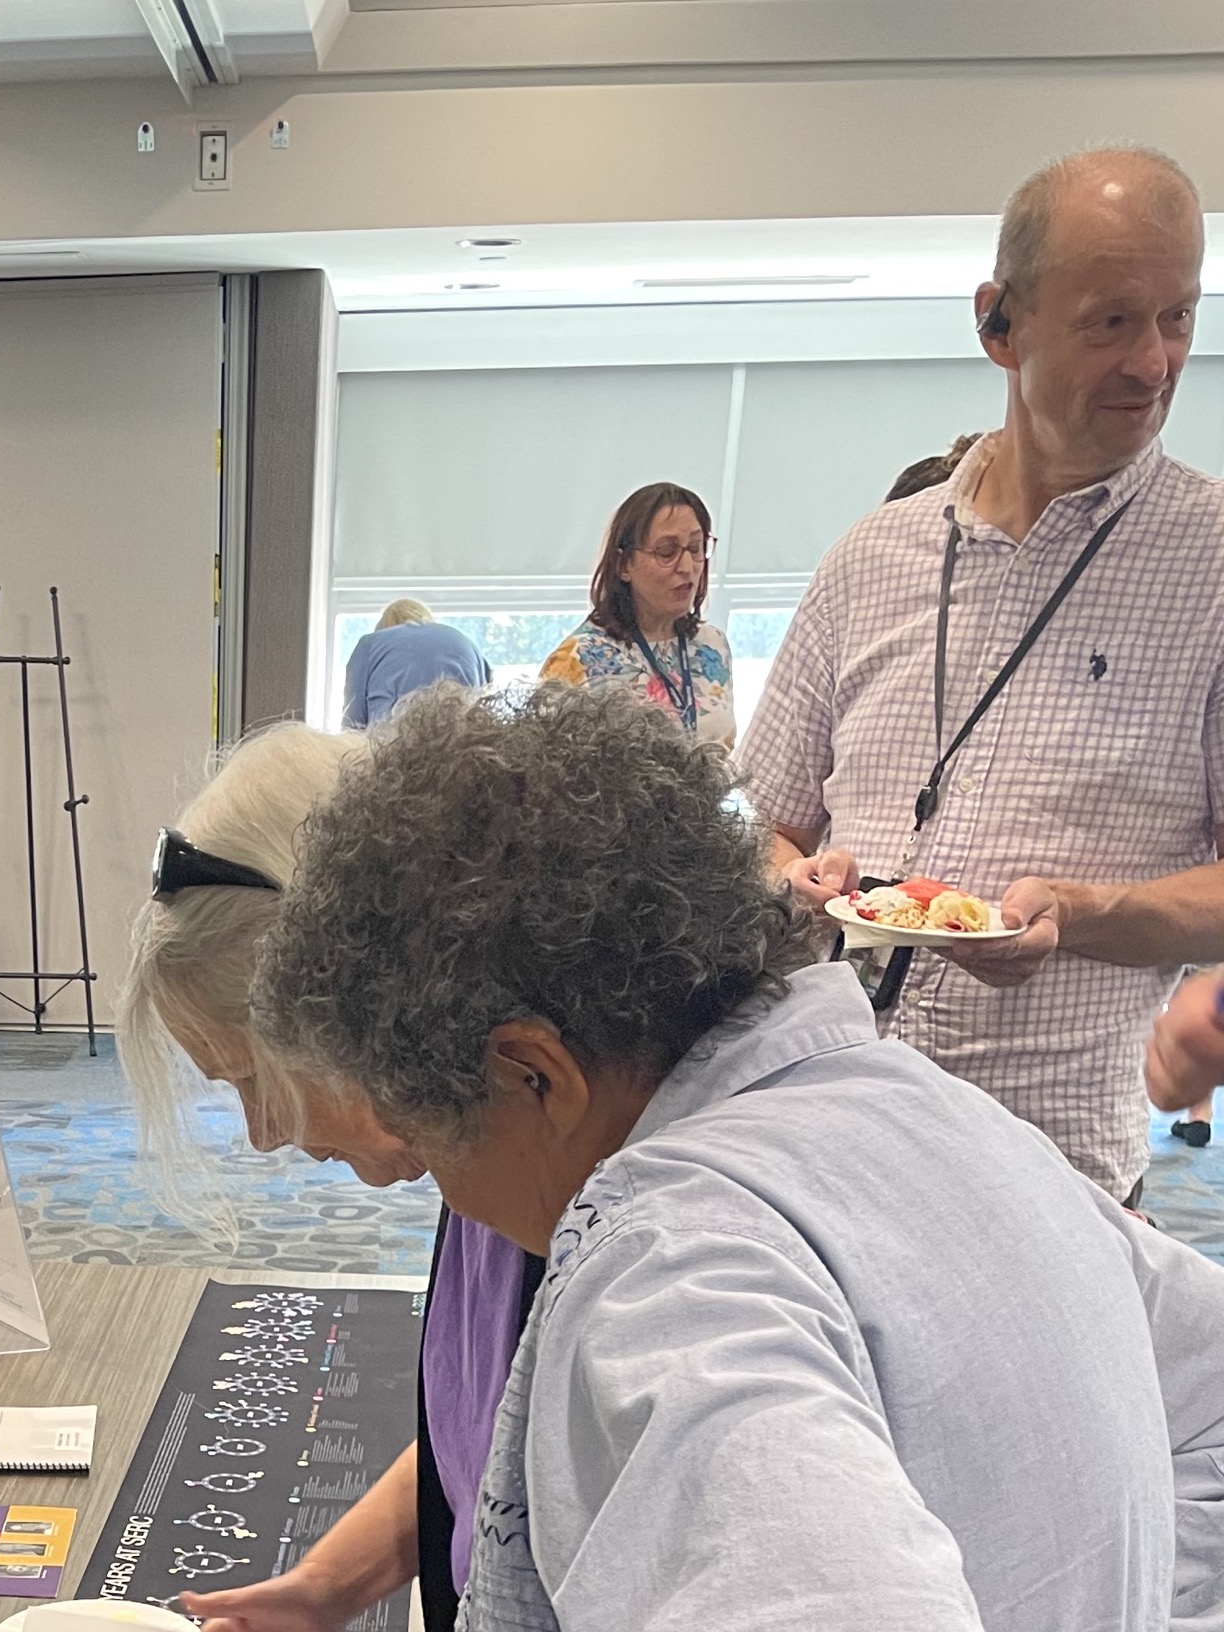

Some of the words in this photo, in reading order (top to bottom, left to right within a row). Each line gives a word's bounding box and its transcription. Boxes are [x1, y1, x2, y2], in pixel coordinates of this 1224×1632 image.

[120, 1515, 153, 1546] SERC
[114, 1544, 141, 1562] AT
[99, 1561, 136, 1599] YEARS
